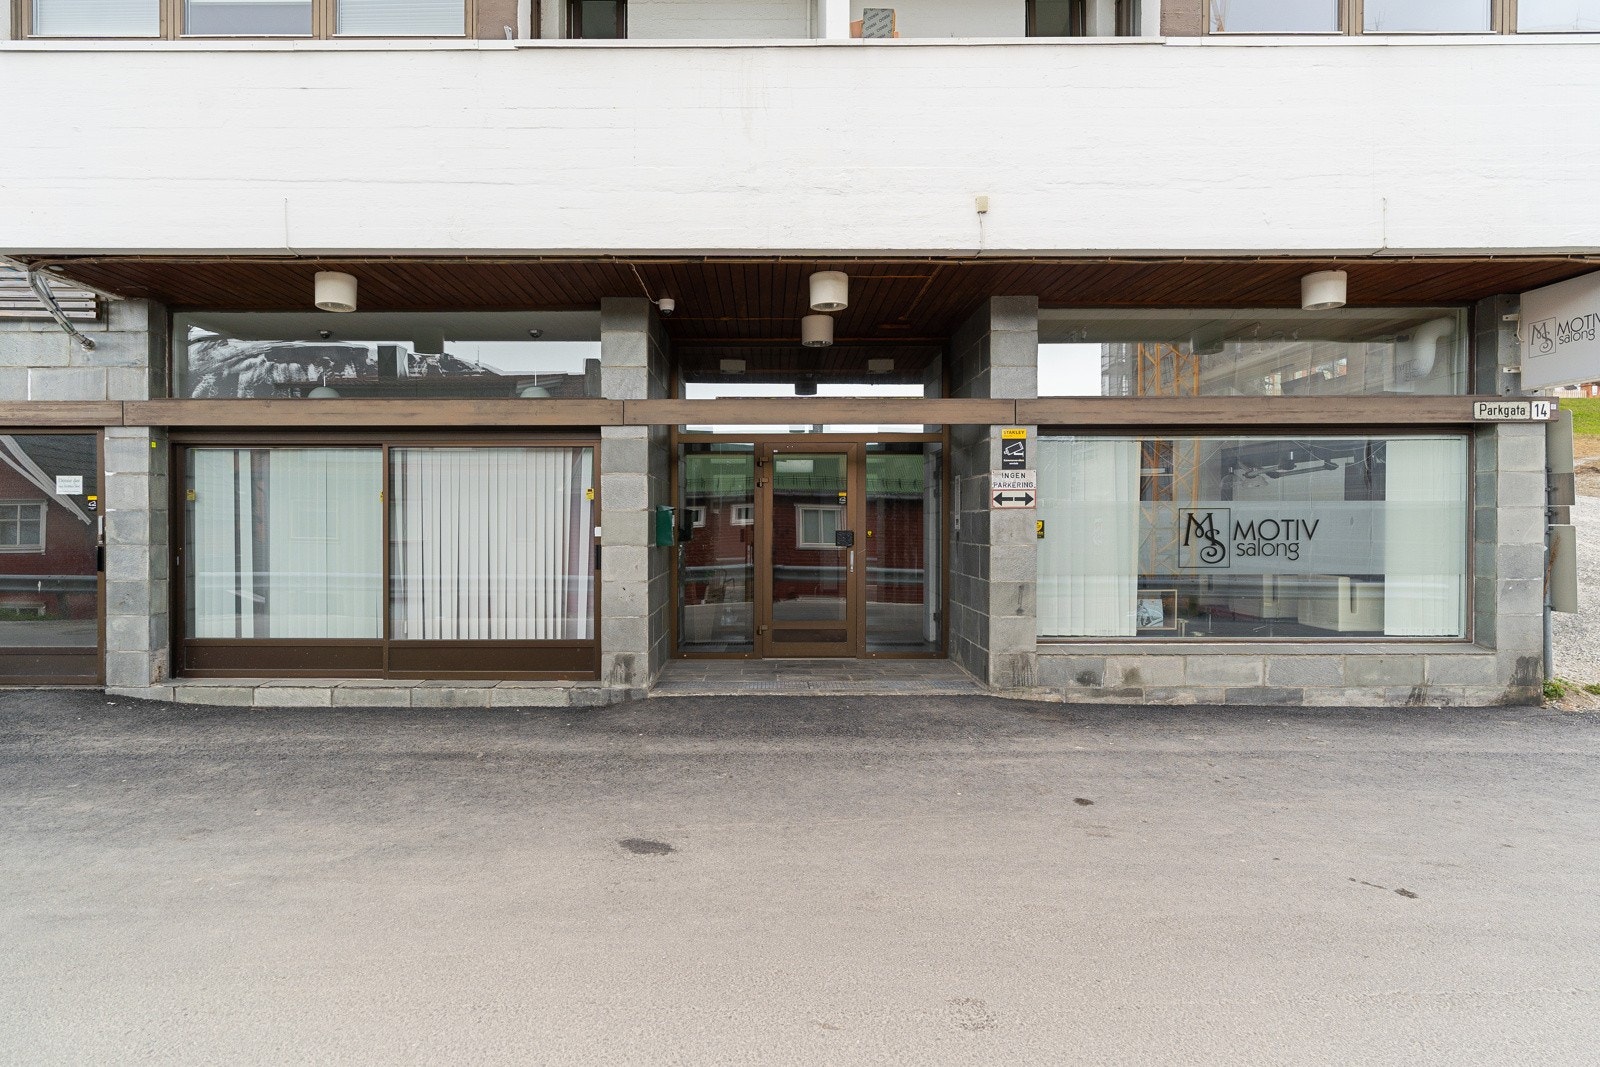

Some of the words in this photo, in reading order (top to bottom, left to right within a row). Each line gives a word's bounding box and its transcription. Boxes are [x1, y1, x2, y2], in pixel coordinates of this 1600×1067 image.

[1558, 328, 1596, 345] salong
[1479, 403, 1526, 418] Parkgata
[1534, 403, 1548, 417] 14
[993, 481, 1034, 489] PARKERING
[1182, 512, 1226, 564] MS
[1233, 518, 1320, 541] MOTIV
[1236, 538, 1300, 561] salong
